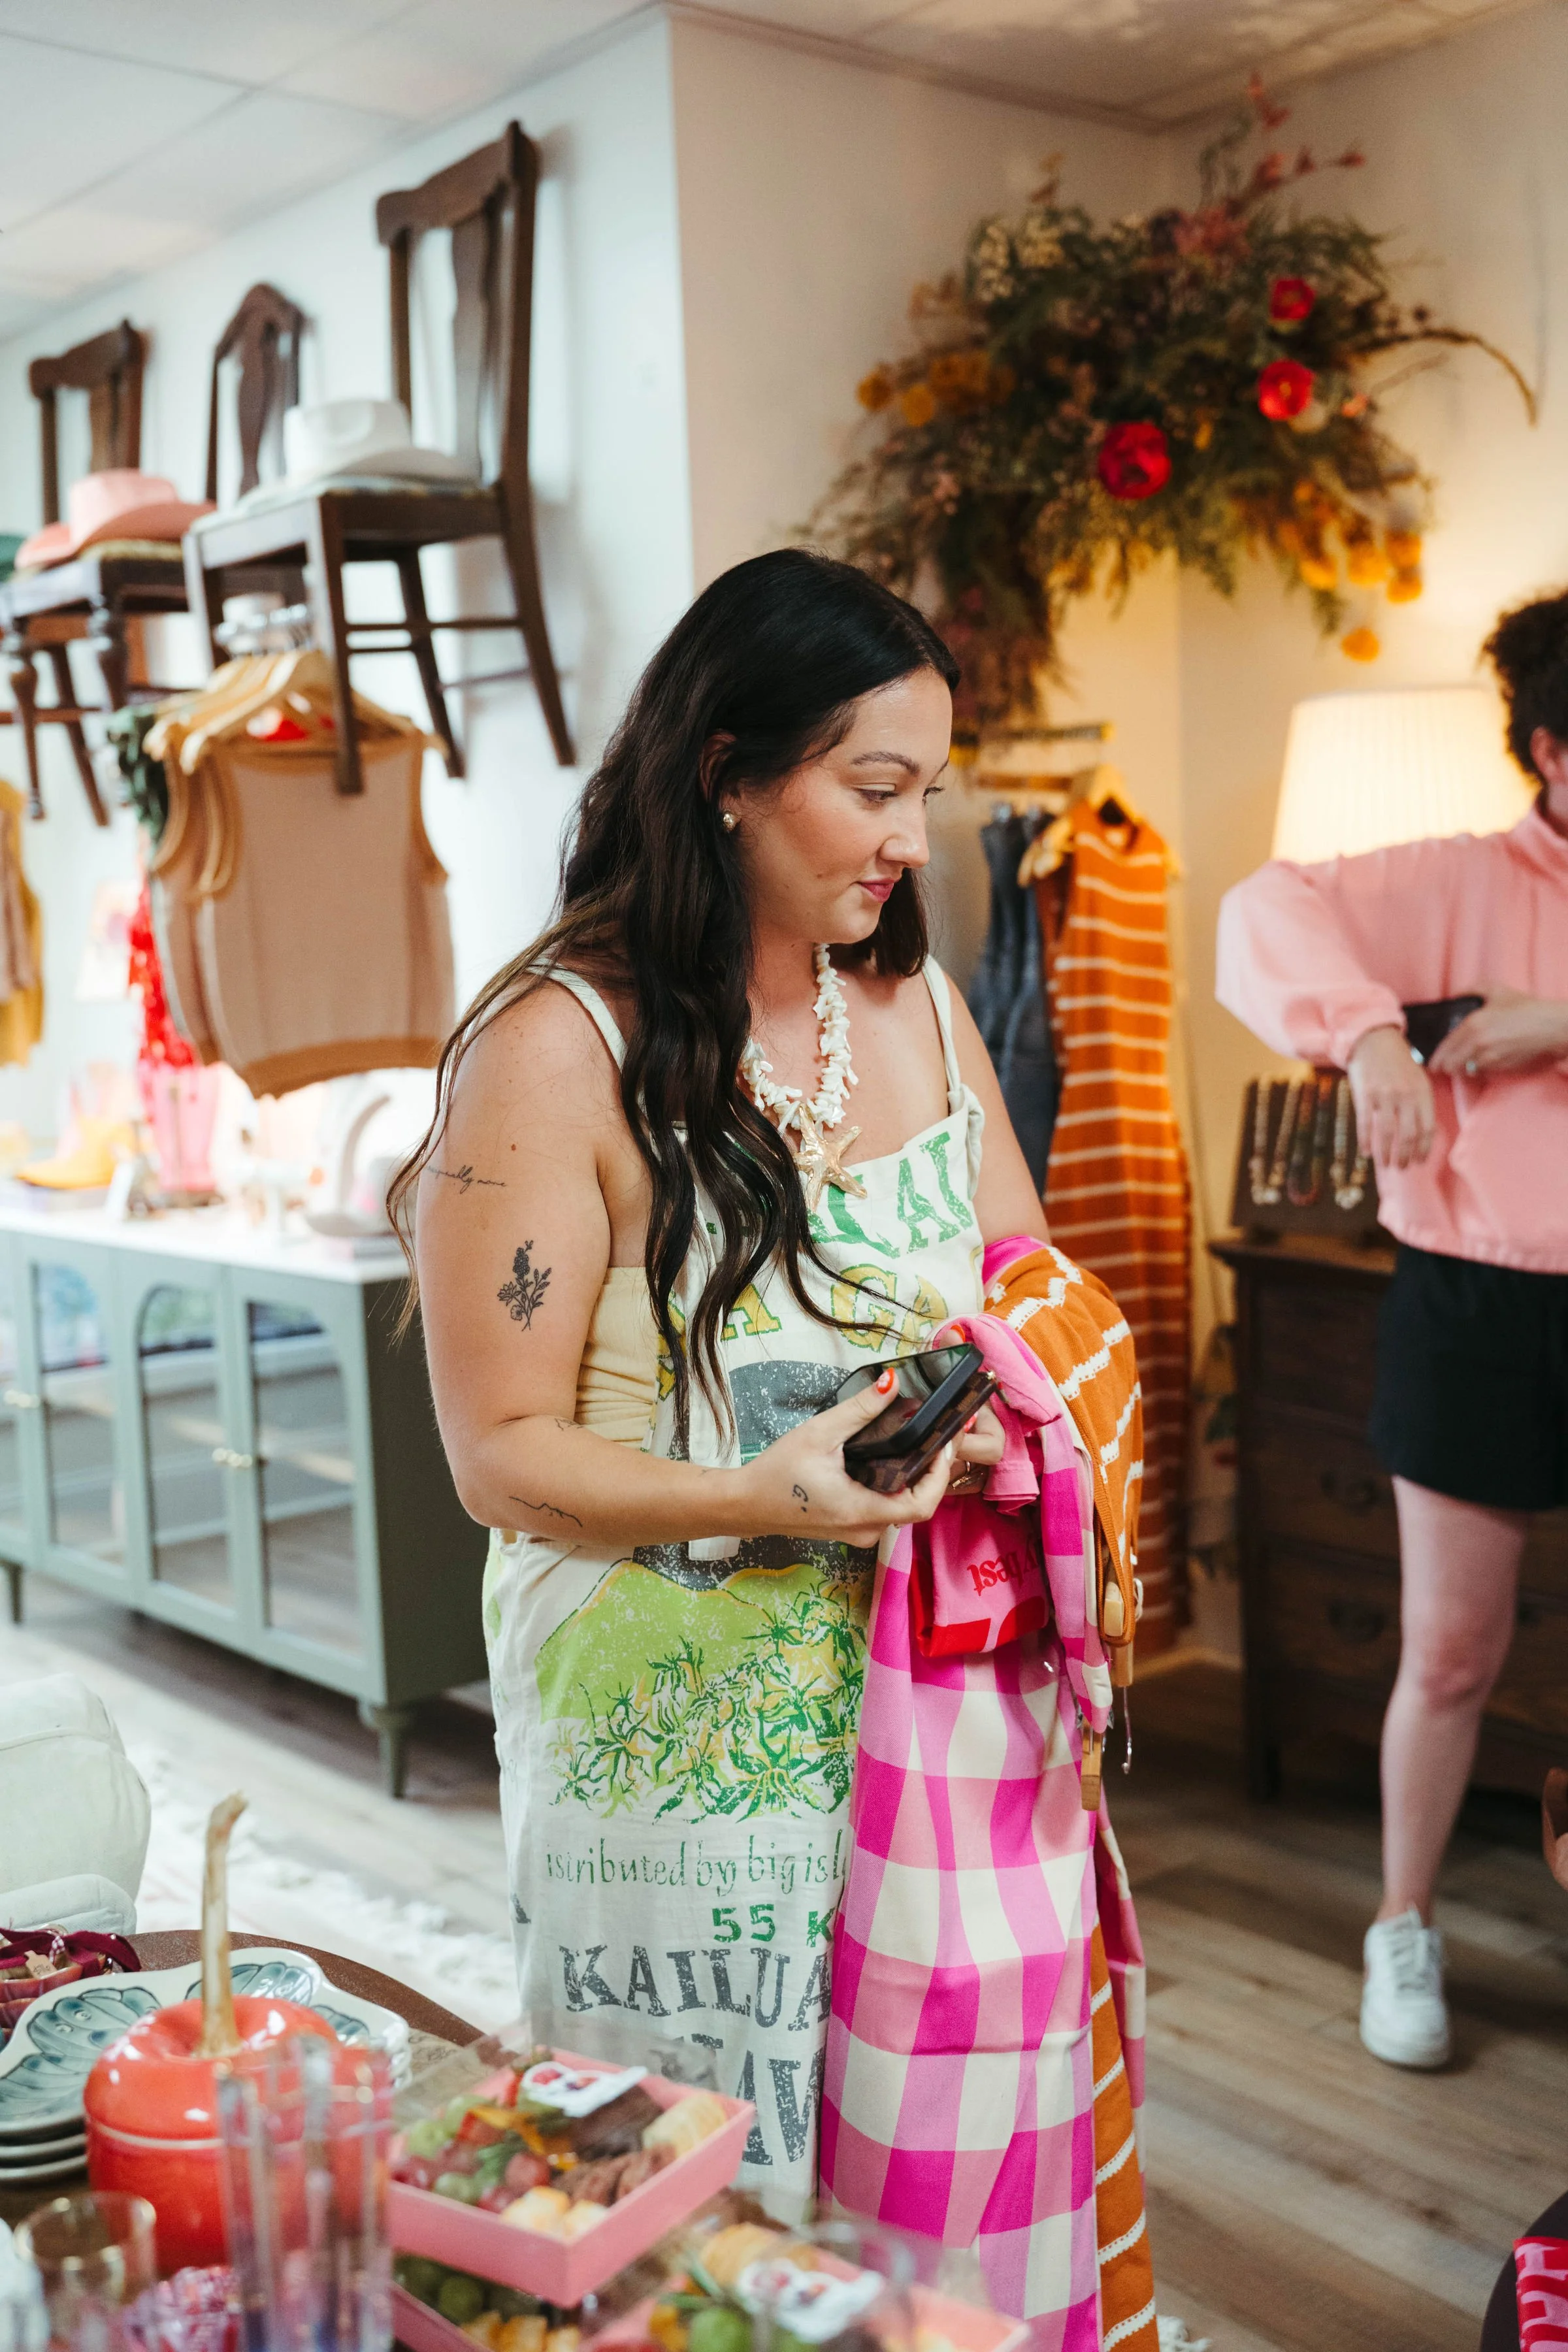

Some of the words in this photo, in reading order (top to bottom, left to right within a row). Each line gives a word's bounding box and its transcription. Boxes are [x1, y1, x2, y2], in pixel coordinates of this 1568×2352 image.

[696, 1839, 737, 1897] by
[748, 1834, 796, 1895] big
[805, 1829, 847, 1883] isl
[559, 1944, 832, 2032] KAILUA
